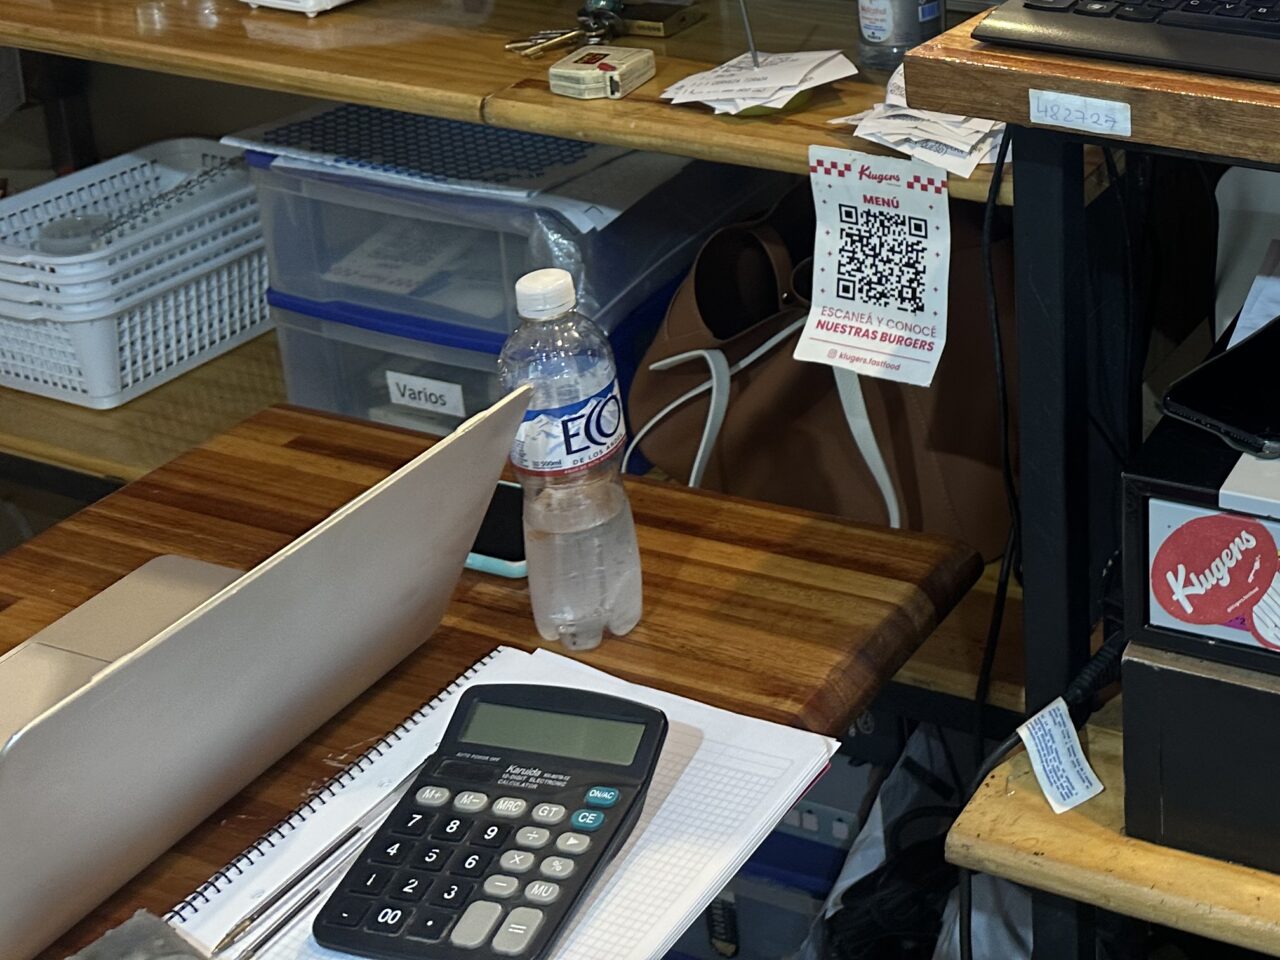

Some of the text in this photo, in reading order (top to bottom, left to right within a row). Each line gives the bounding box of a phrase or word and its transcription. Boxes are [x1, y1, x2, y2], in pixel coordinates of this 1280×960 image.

[857, 164, 901, 184] Klugers
[862, 194, 900, 209] MENÚ
[820, 306, 937, 338] ESCANEÁ Y CONOCÉ
[815, 319, 935, 352] NUESTRAS BURGERS
[839, 351, 901, 371] klugers.fastfood
[396, 382, 447, 407] Varios
[562, 395, 620, 456] ECO
[588, 450, 604, 461] LOS
[1166, 529, 1257, 614] Klugers
[506, 765, 542, 776] Karuida
[498, 779, 538, 789] CALCULATOR
[422, 788, 615, 818] M+ MRC GT ON/AC
[407, 815, 422, 828] 7
[578, 812, 595, 824] CE
[446, 820, 460, 833] 8
[484, 827, 498, 840] 9
[386, 843, 400, 856] 4
[464, 855, 478, 868] 6
[403, 879, 418, 892] 2
[530, 885, 552, 896] MU
[443, 886, 458, 900] 3
[377, 908, 402, 925] 00
